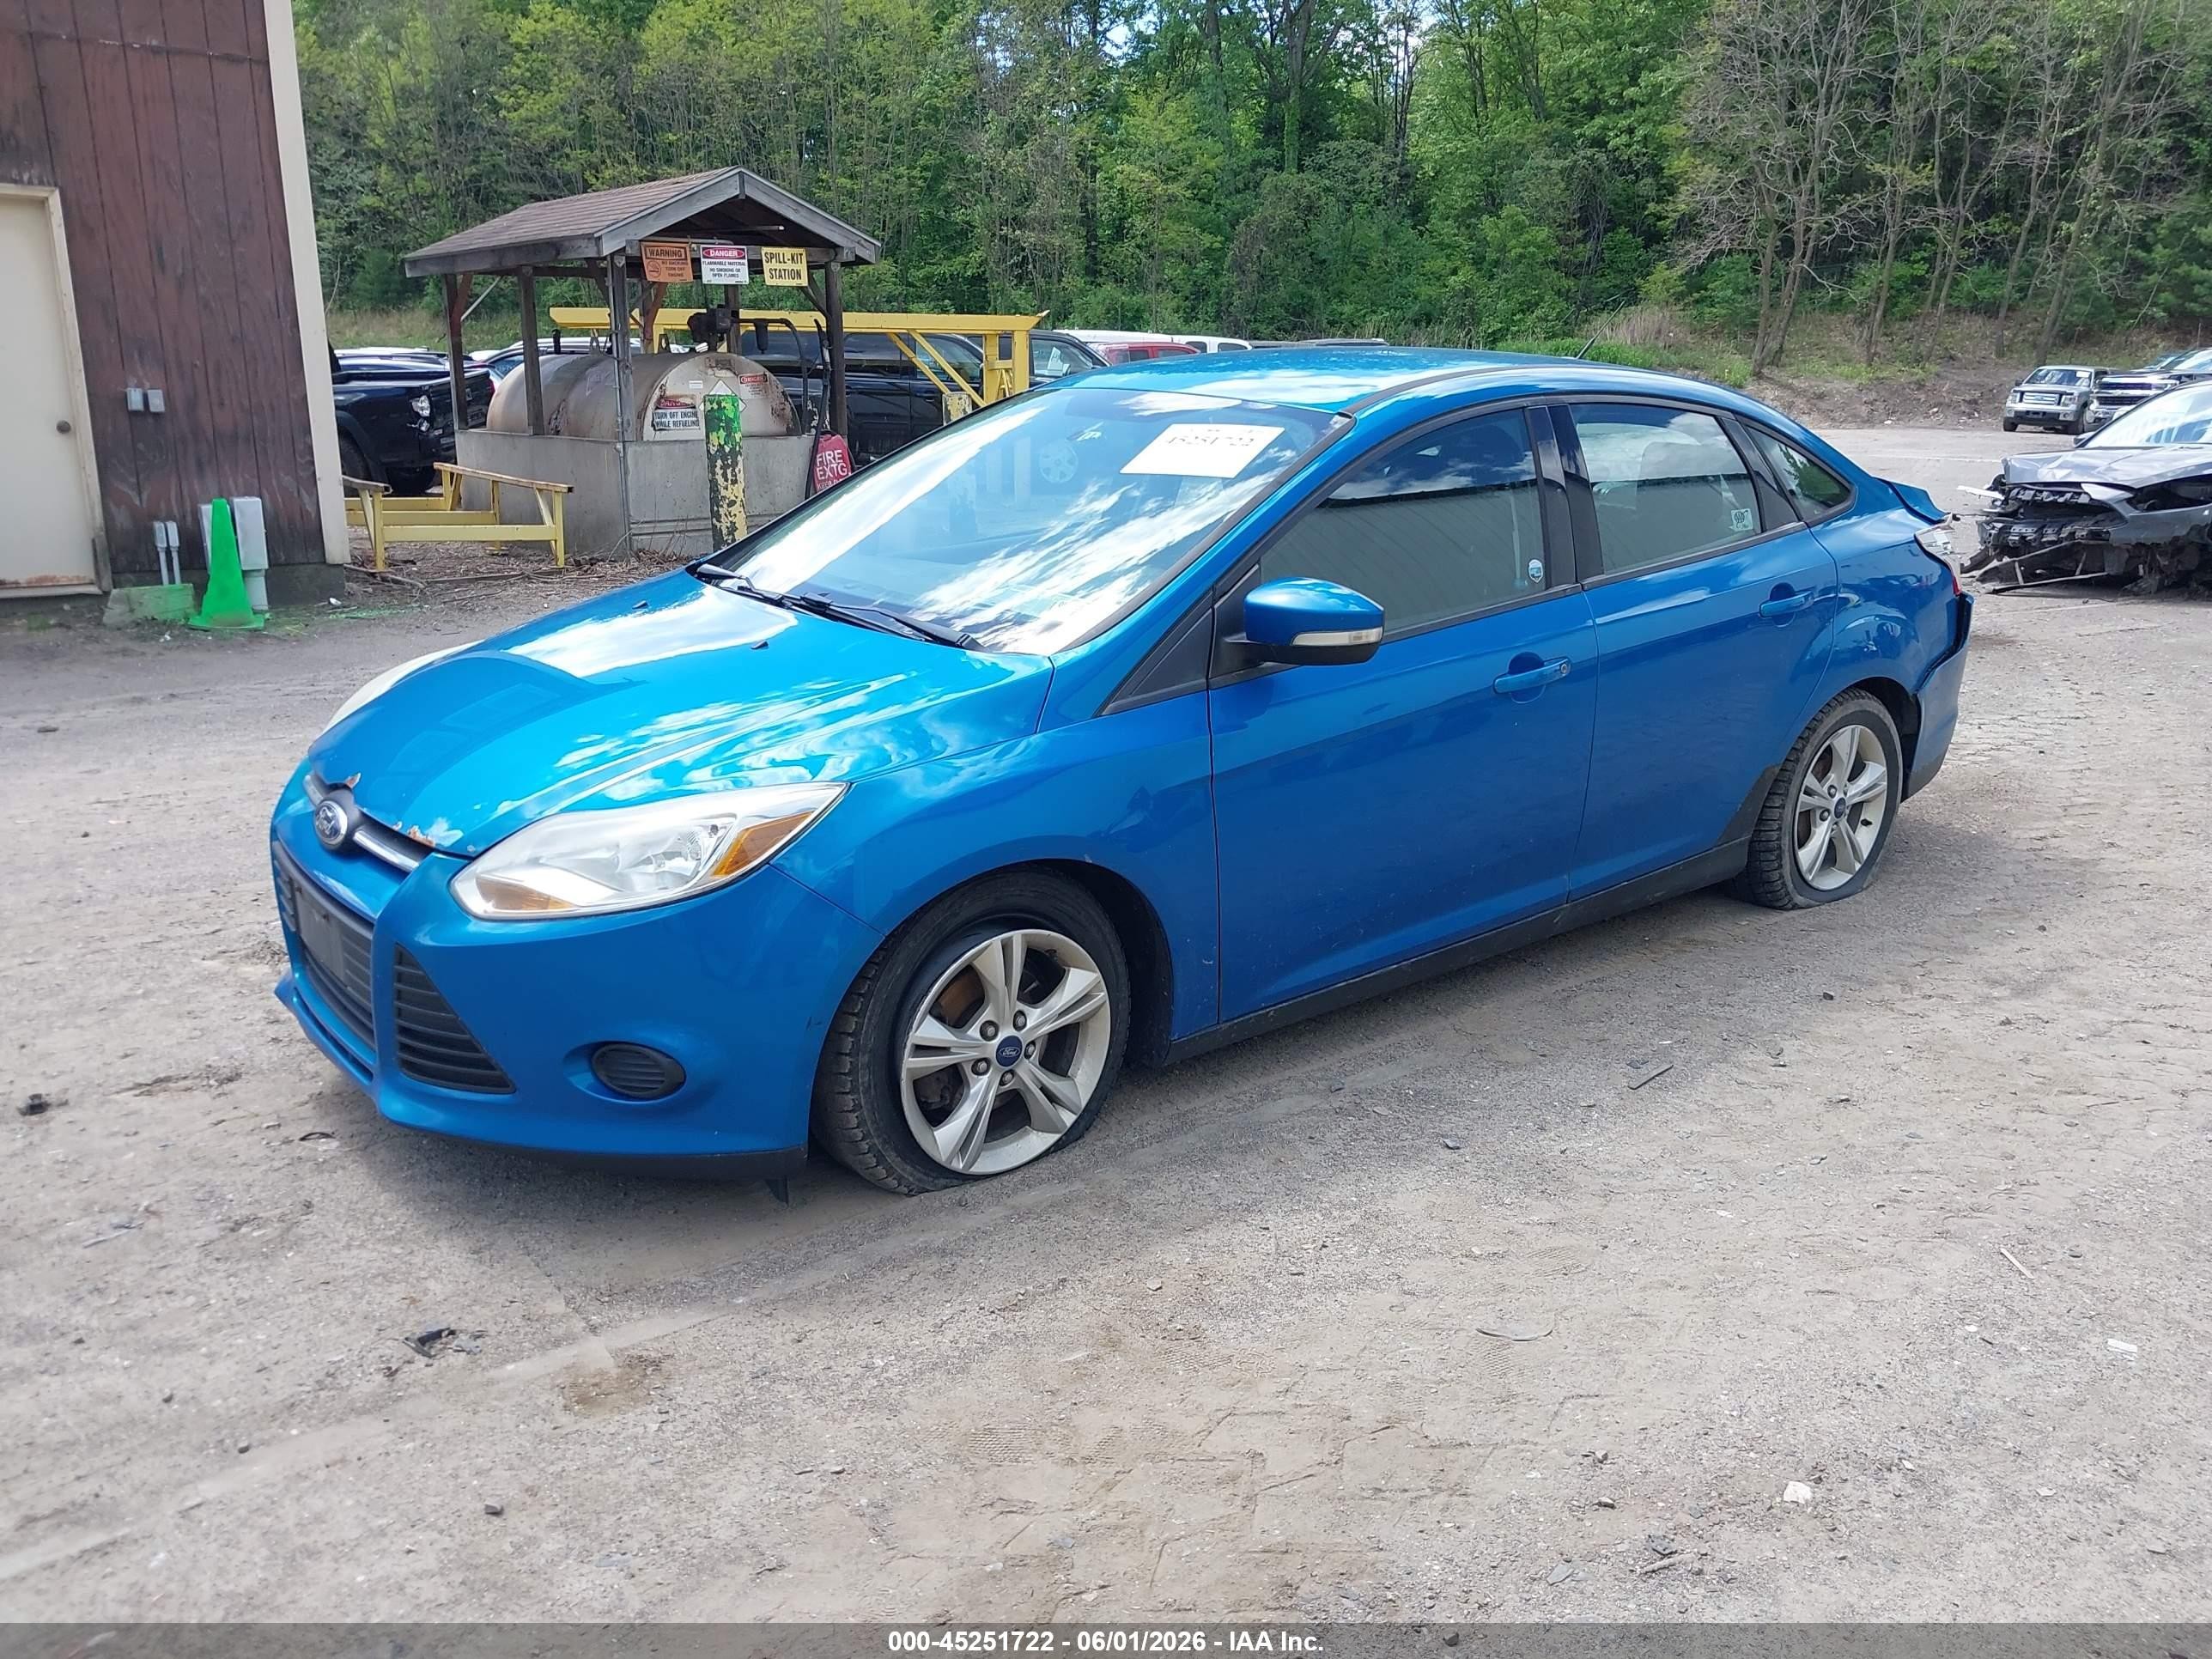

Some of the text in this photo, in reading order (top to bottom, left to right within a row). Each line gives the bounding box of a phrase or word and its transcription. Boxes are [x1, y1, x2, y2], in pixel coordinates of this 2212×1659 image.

[648, 248, 683, 258] WARNING
[764, 252, 804, 264] SPILL-KIT
[769, 268, 802, 280] STATION
[816, 449, 843, 467] FIRE
